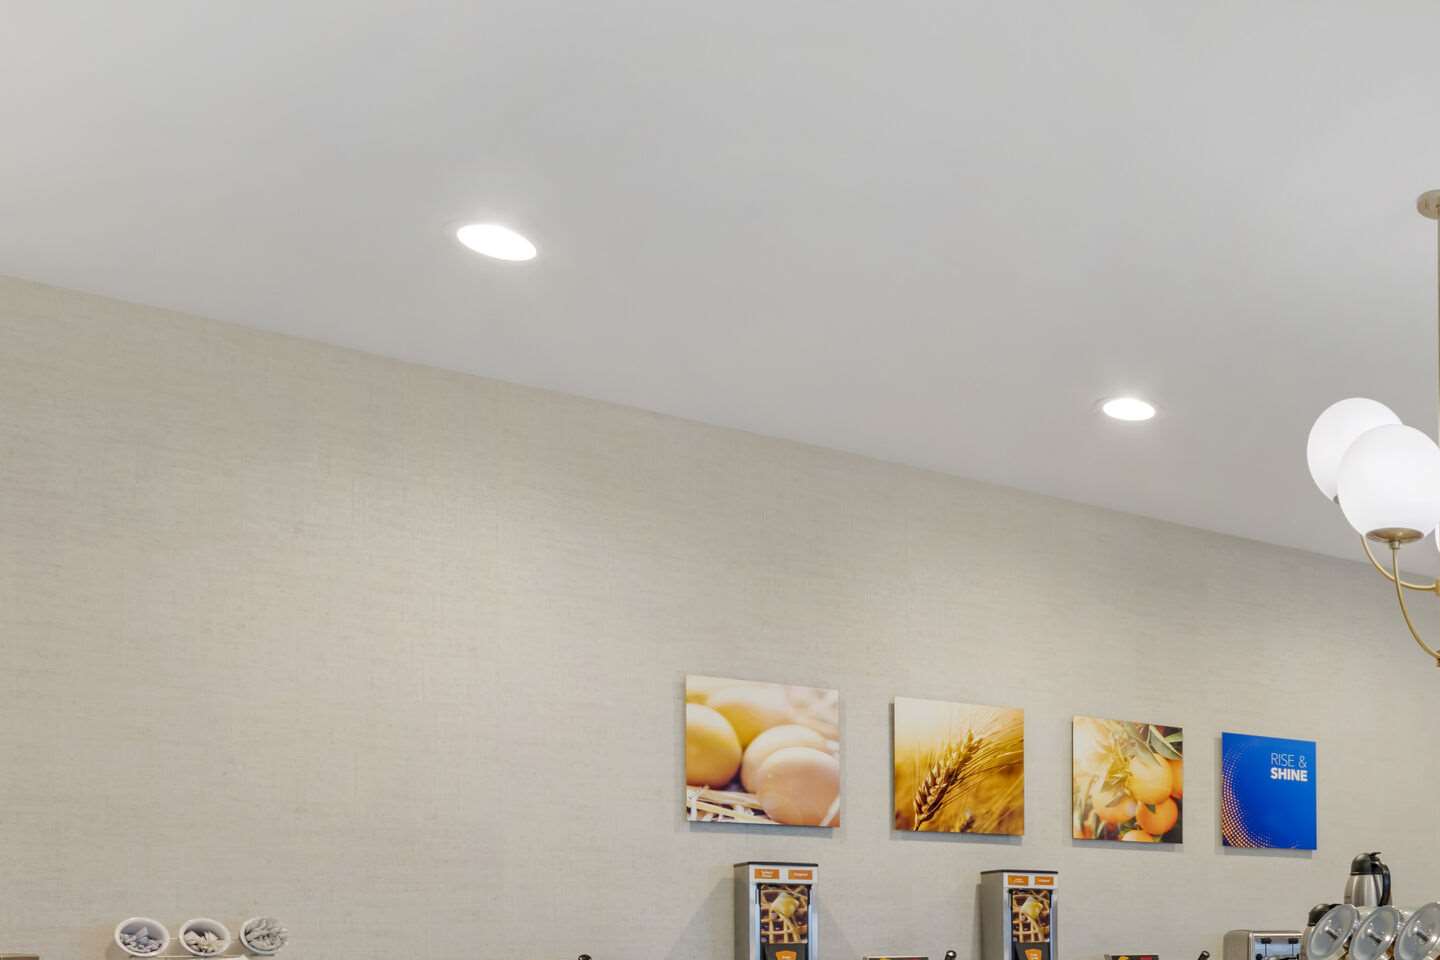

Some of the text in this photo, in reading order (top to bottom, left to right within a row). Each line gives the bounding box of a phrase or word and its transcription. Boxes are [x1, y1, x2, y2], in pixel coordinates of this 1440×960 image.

[1270, 752, 1307, 769] RISE &
[1270, 767, 1308, 782] SHINE
